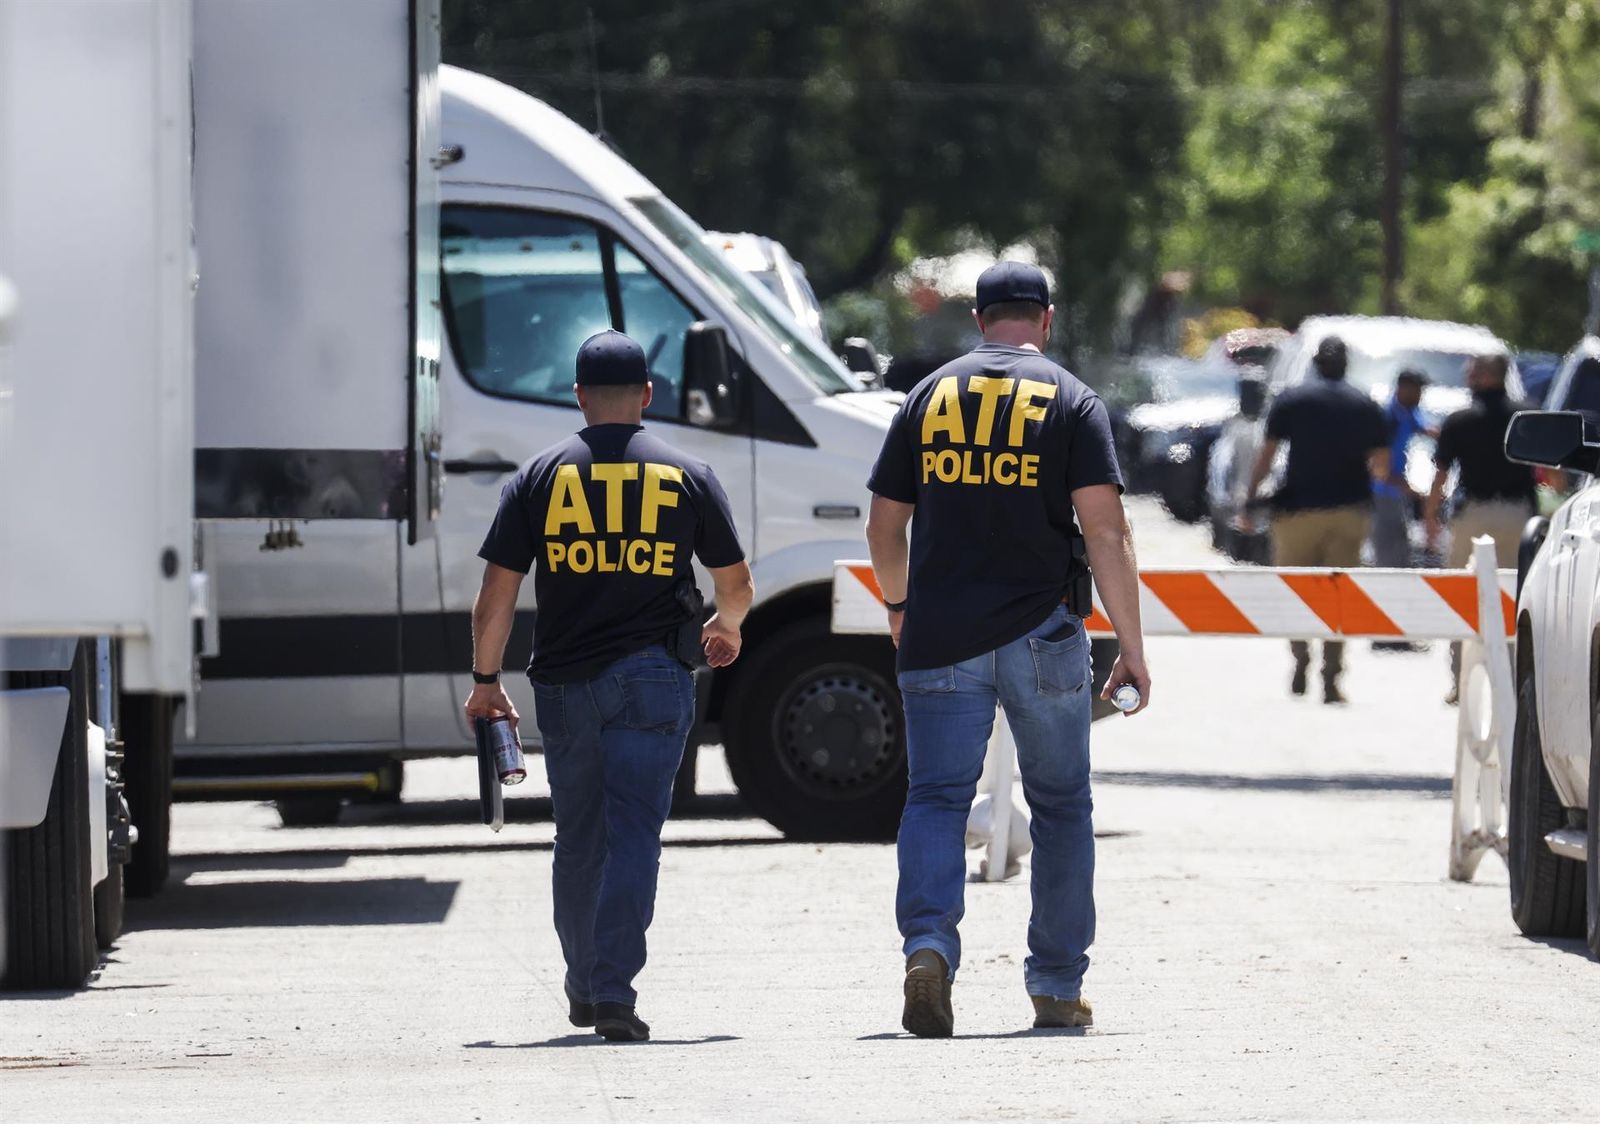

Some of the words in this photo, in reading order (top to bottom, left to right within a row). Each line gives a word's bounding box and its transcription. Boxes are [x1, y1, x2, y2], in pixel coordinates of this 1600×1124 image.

[921, 375, 1058, 447] ATF
[922, 449, 1040, 487] POLICE
[544, 462, 684, 536] ATF
[546, 539, 676, 577] POLICE
